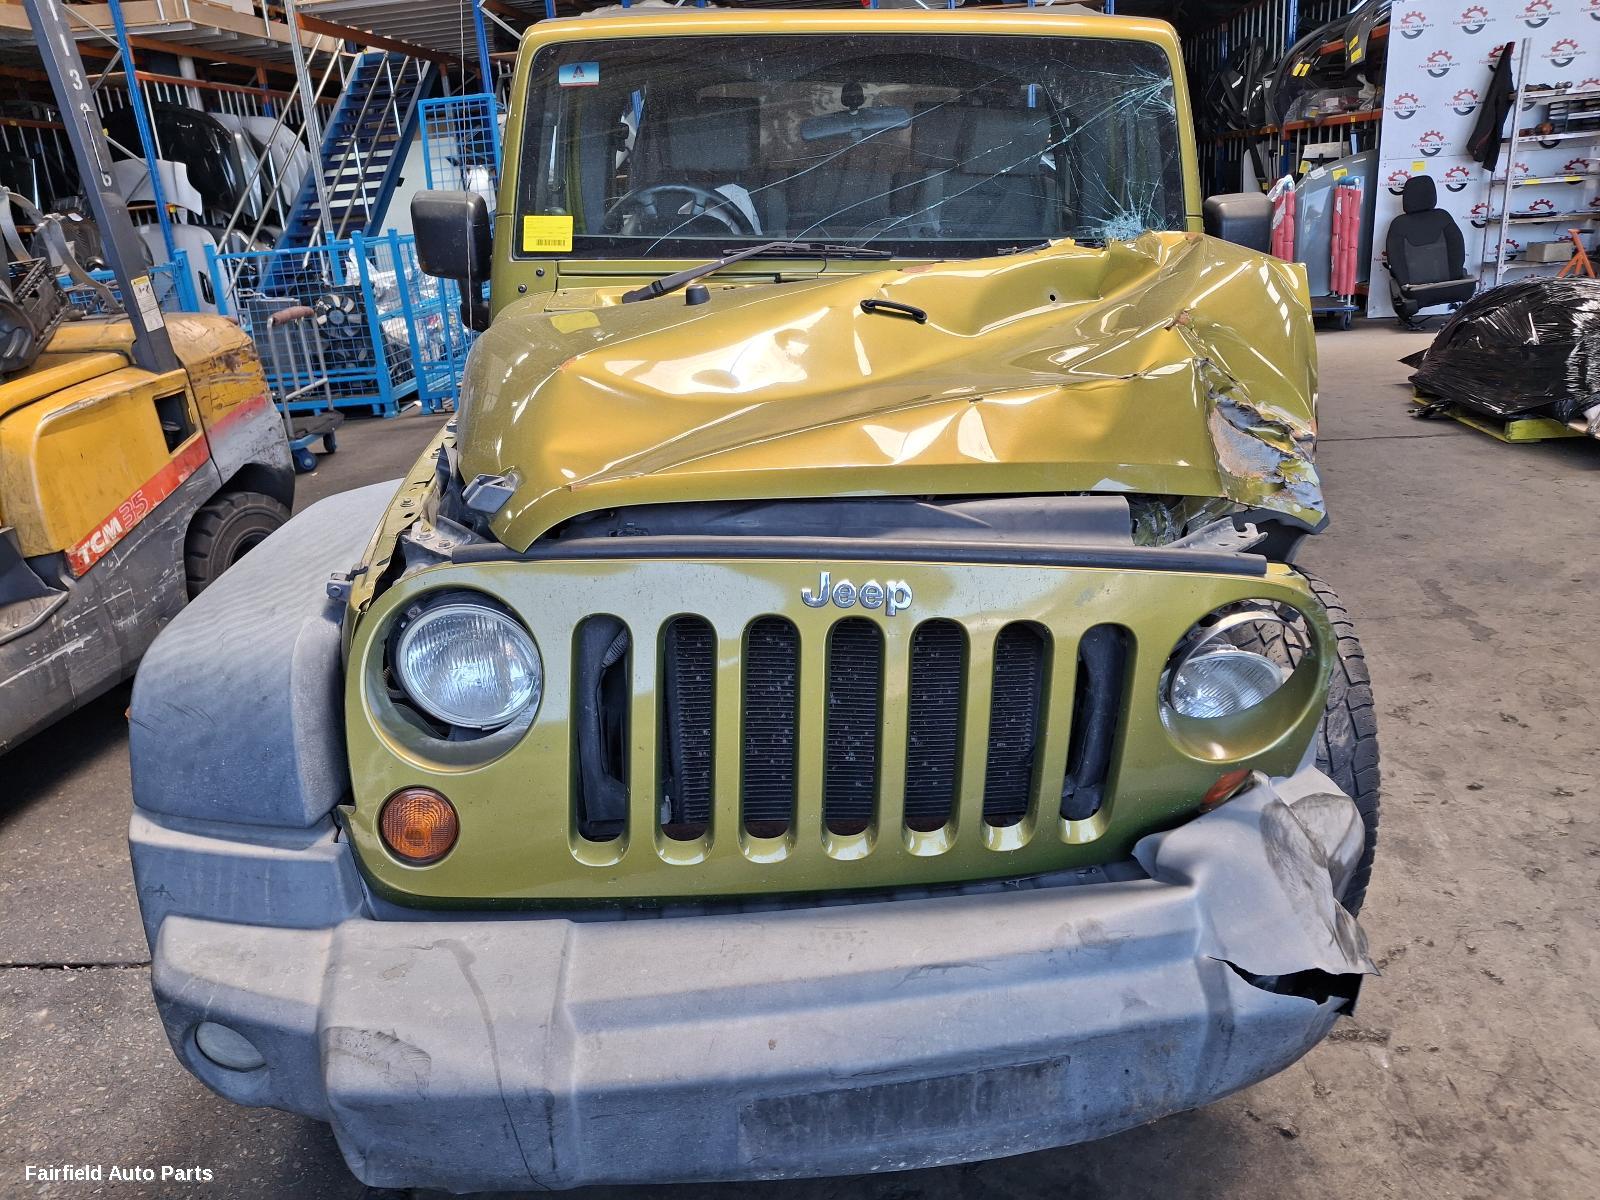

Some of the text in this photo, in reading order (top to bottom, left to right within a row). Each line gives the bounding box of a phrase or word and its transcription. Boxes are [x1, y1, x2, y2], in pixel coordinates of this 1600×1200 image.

[77, 489, 150, 564] TCM 35
[801, 571, 913, 616] Jeep
